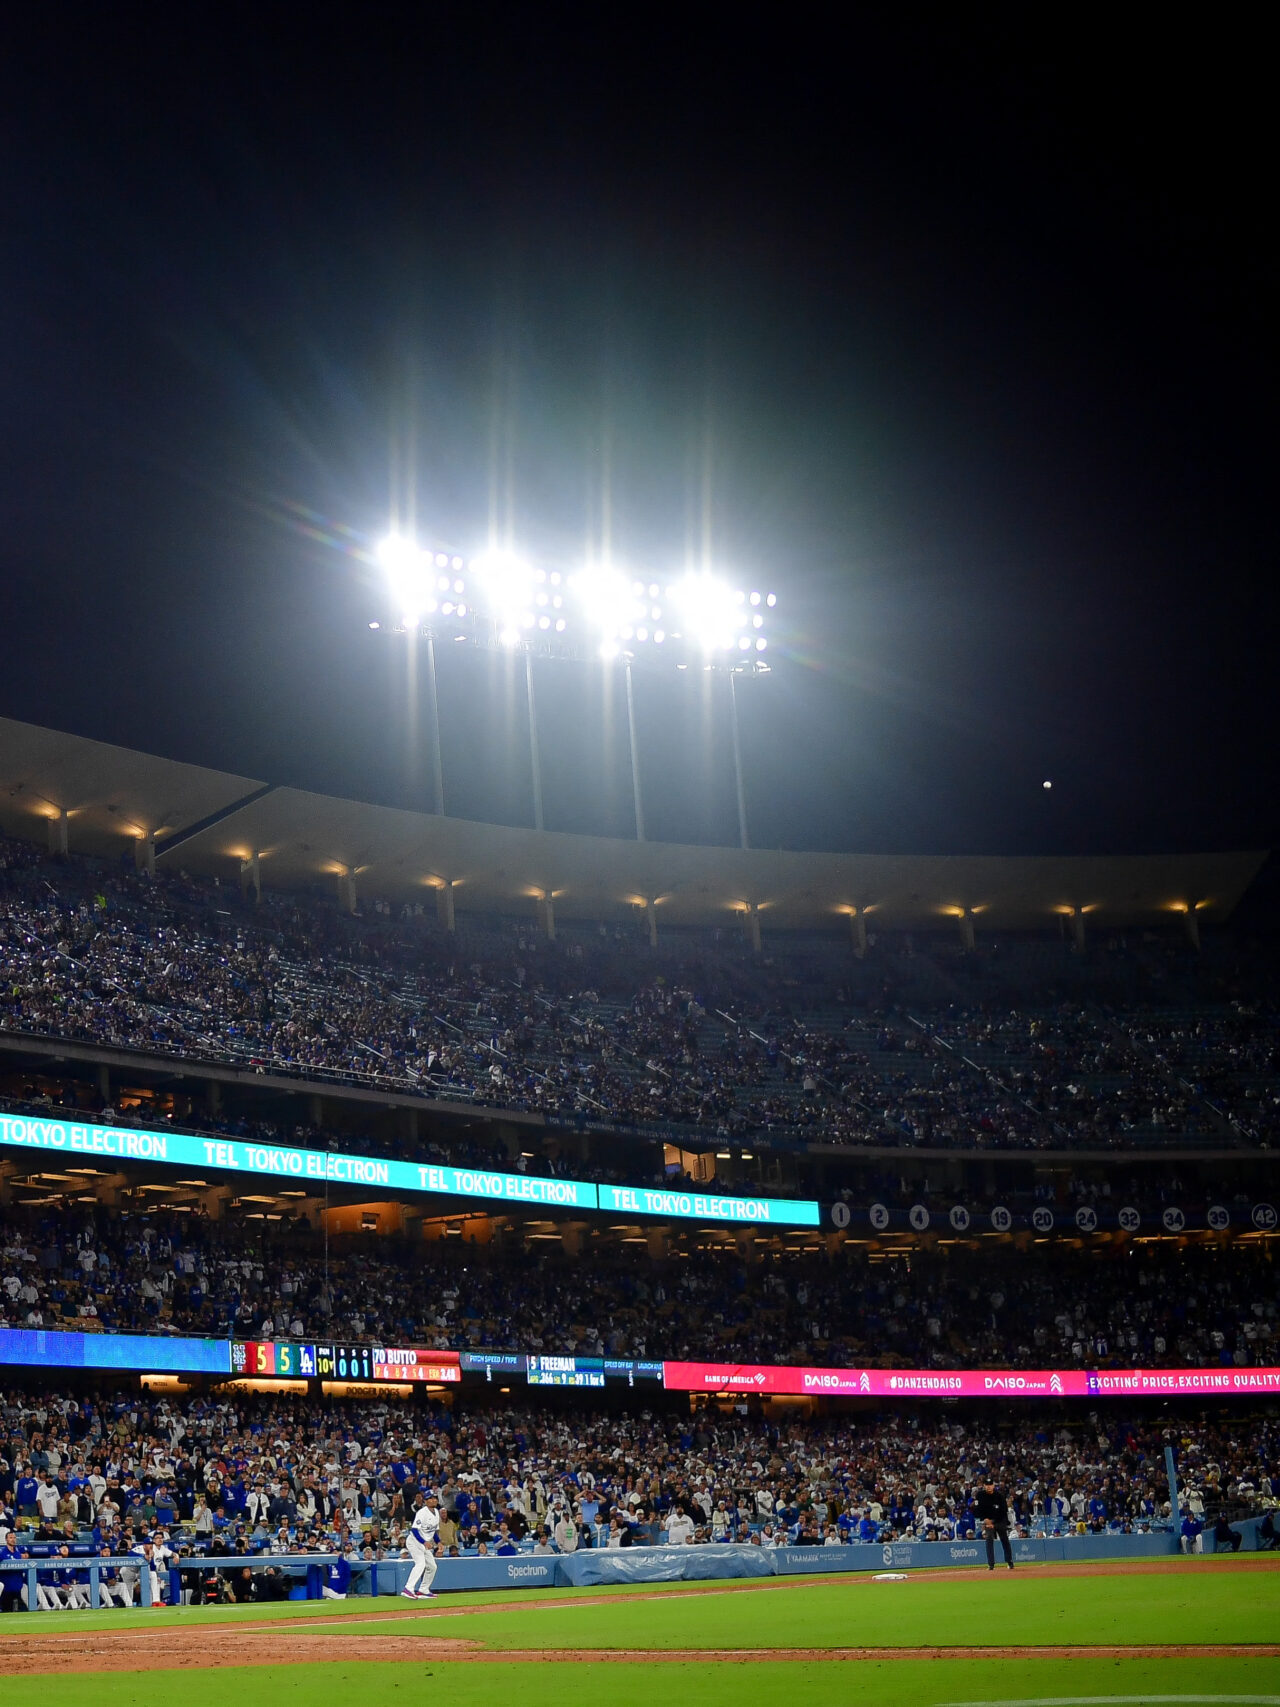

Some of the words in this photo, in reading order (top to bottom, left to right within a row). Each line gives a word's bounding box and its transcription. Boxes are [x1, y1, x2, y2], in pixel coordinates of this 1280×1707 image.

[0, 1117, 66, 1147] TOKYO
[71, 1127, 167, 1158] ELECTRON
[203, 1141, 239, 1167] TEL
[245, 1147, 303, 1173] TOKYO
[306, 1153, 389, 1183] ELECTRON
[418, 1167, 449, 1190] TEL
[453, 1171, 503, 1195] TOKYO
[506, 1174, 577, 1202] ELECTRON
[612, 1188, 640, 1210] TEL
[645, 1192, 692, 1215] TOKYO
[694, 1197, 770, 1220] ELECTRON
[257, 1345, 267, 1371] 5
[280, 1346, 290, 1372] 5
[299, 1346, 314, 1373] LA
[339, 1349, 345, 1357] B
[351, 1349, 356, 1357] S
[362, 1349, 368, 1357] O
[374, 1349, 386, 1364] 70
[387, 1349, 417, 1365] BUTTO
[470, 1355, 484, 1363] PITCH
[485, 1355, 500, 1363] SPEED
[505, 1356, 517, 1364] TYPE
[317, 1358, 329, 1373] 10
[339, 1359, 347, 1377] 0
[351, 1359, 359, 1377] 0
[362, 1359, 368, 1377] 1
[530, 1356, 537, 1370] 5
[540, 1356, 576, 1371] FREEMAN
[383, 1366, 389, 1379] 6
[402, 1366, 408, 1379] 2
[418, 1368, 424, 1379] 4
[561, 1373, 567, 1384] 9
[721, 1375, 729, 1383] OF
[729, 1376, 754, 1384] AMERICA
[805, 1375, 839, 1388] DAISO
[984, 1377, 1026, 1389] DAISO
[507, 1564, 545, 1580] Spectrum
